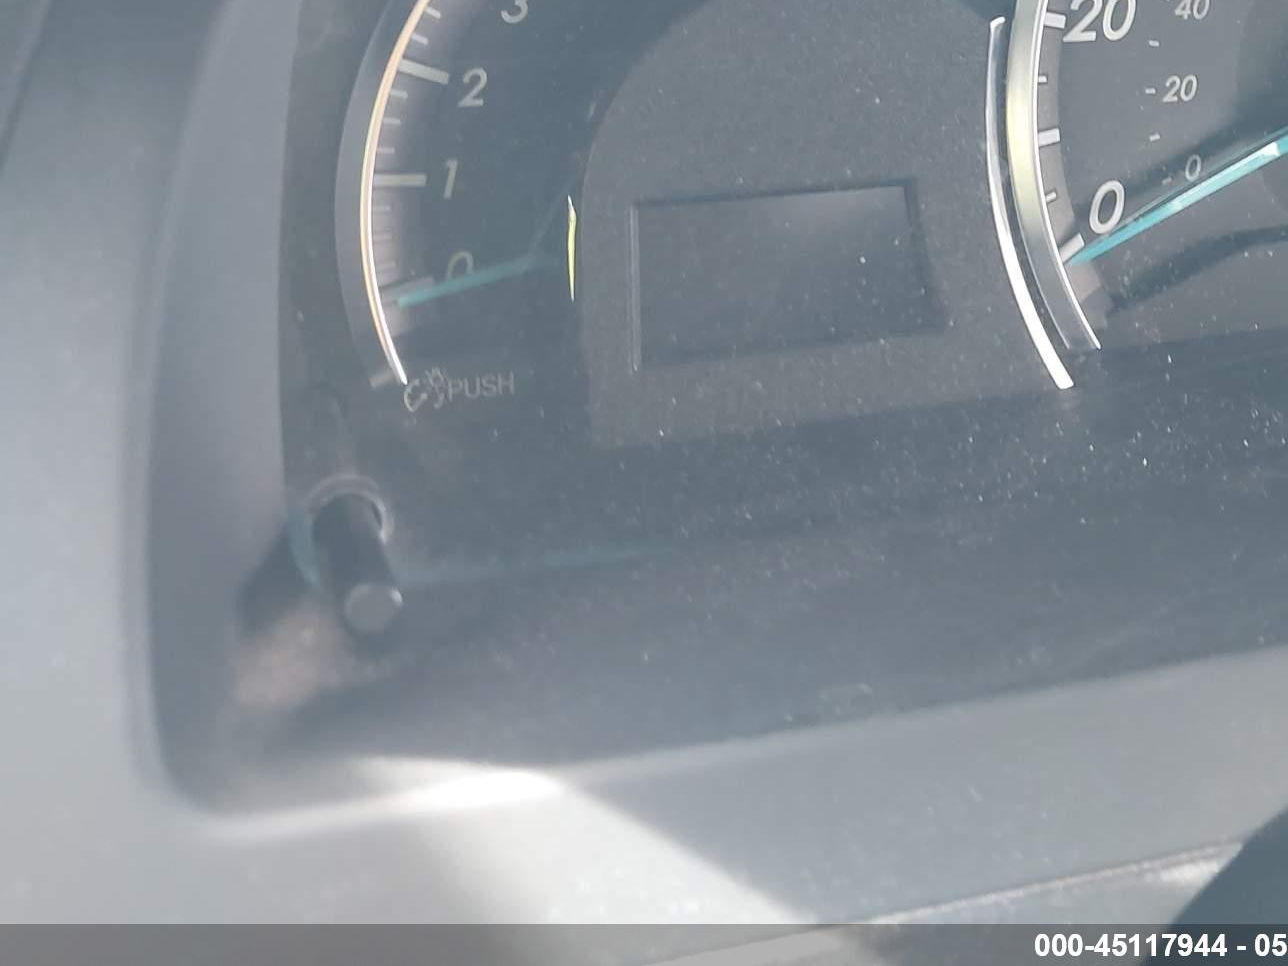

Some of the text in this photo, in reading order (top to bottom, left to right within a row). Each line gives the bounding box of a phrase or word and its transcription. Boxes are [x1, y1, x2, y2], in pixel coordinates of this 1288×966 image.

[458, 66, 488, 107] 2
[1162, 76, 1198, 103] 20
[443, 159, 459, 198] 1
[1184, 154, 1201, 180] 0
[1088, 180, 1126, 233] 0
[448, 372, 515, 402] PUSH
